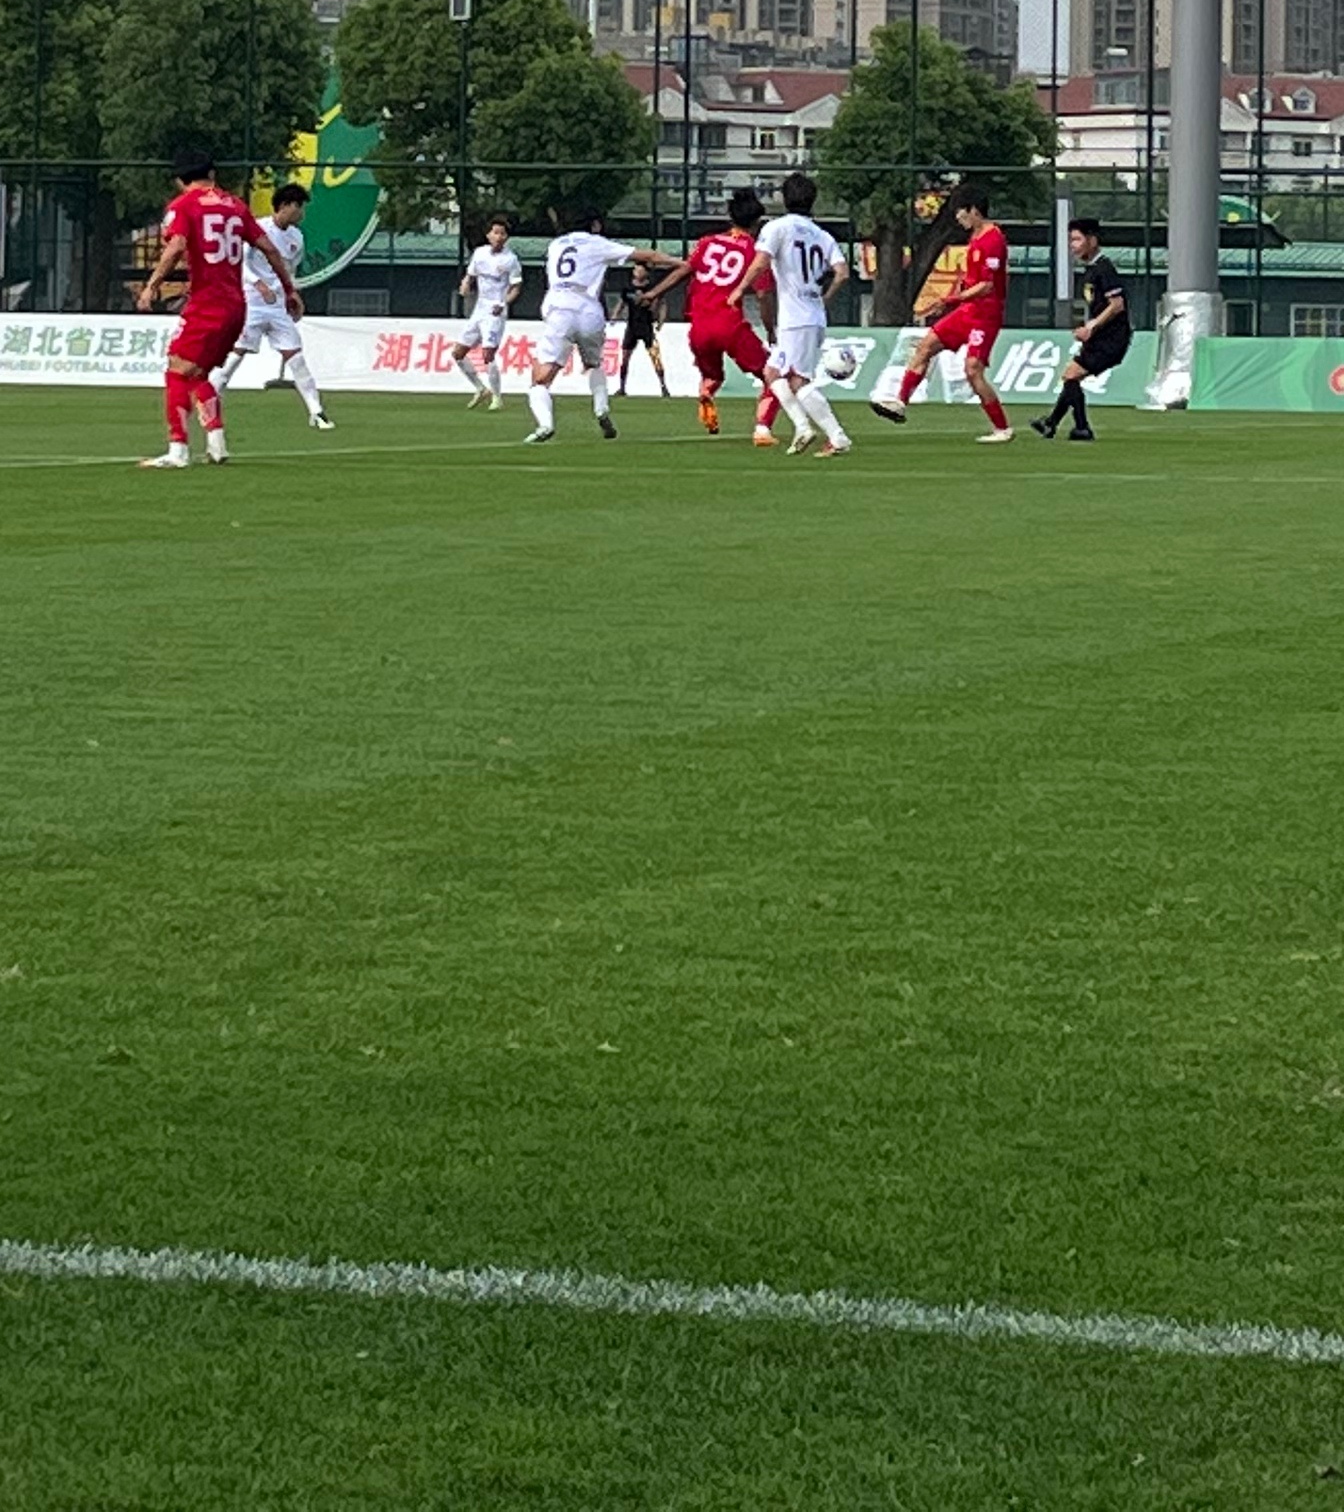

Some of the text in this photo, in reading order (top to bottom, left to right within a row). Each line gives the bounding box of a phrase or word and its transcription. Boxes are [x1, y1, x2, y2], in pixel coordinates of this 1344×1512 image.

[202, 213, 244, 265] 56
[556, 246, 578, 279] 6
[695, 242, 745, 286] 59
[793, 240, 825, 285] 10
[45, 360, 117, 374] FOOTBALL
